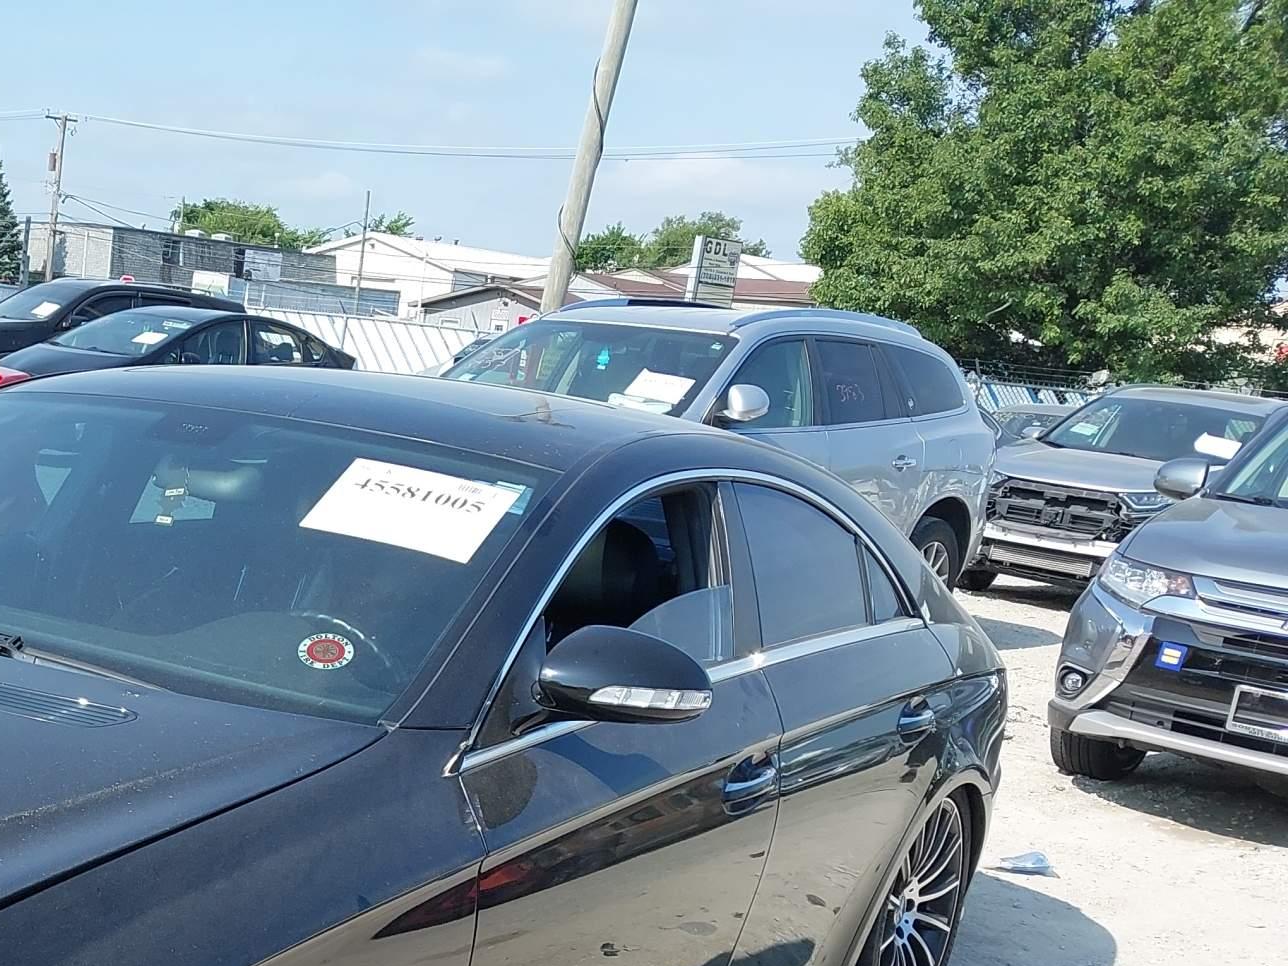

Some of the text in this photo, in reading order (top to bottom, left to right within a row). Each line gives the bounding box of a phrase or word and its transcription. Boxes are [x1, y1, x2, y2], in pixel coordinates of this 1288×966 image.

[705, 240, 729, 257] GDL
[354, 478, 485, 513] 45581005
[308, 634, 351, 647] DOLTON
